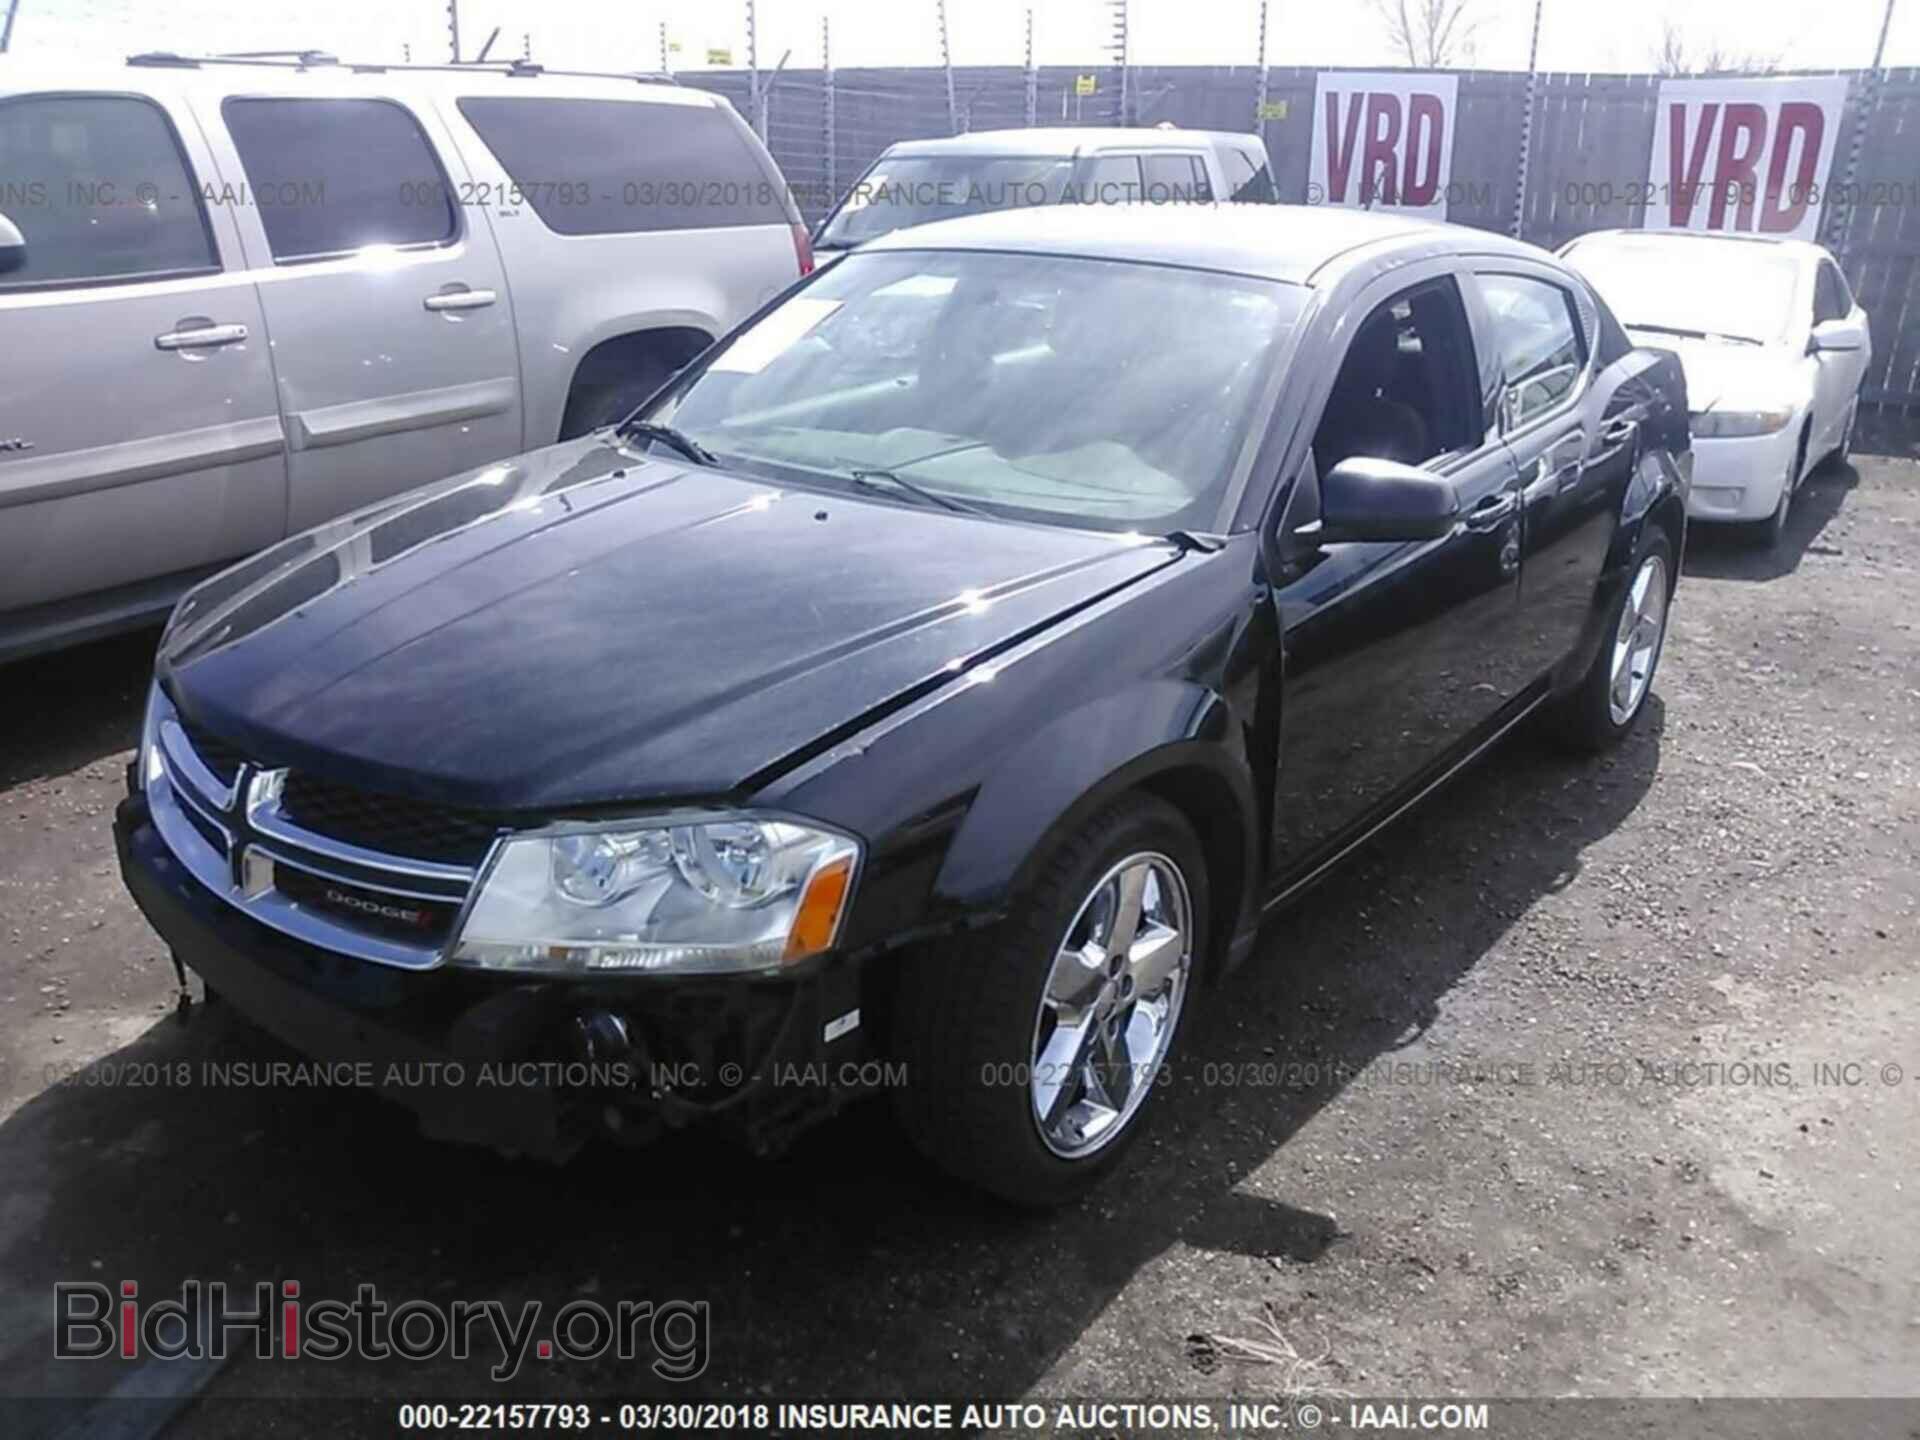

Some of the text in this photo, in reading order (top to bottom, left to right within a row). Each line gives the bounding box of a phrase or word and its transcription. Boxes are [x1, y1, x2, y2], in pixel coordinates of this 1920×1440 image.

[1326, 91, 1444, 207] VRD
[1669, 102, 1825, 234] VRD
[327, 889, 418, 921] DODGE
